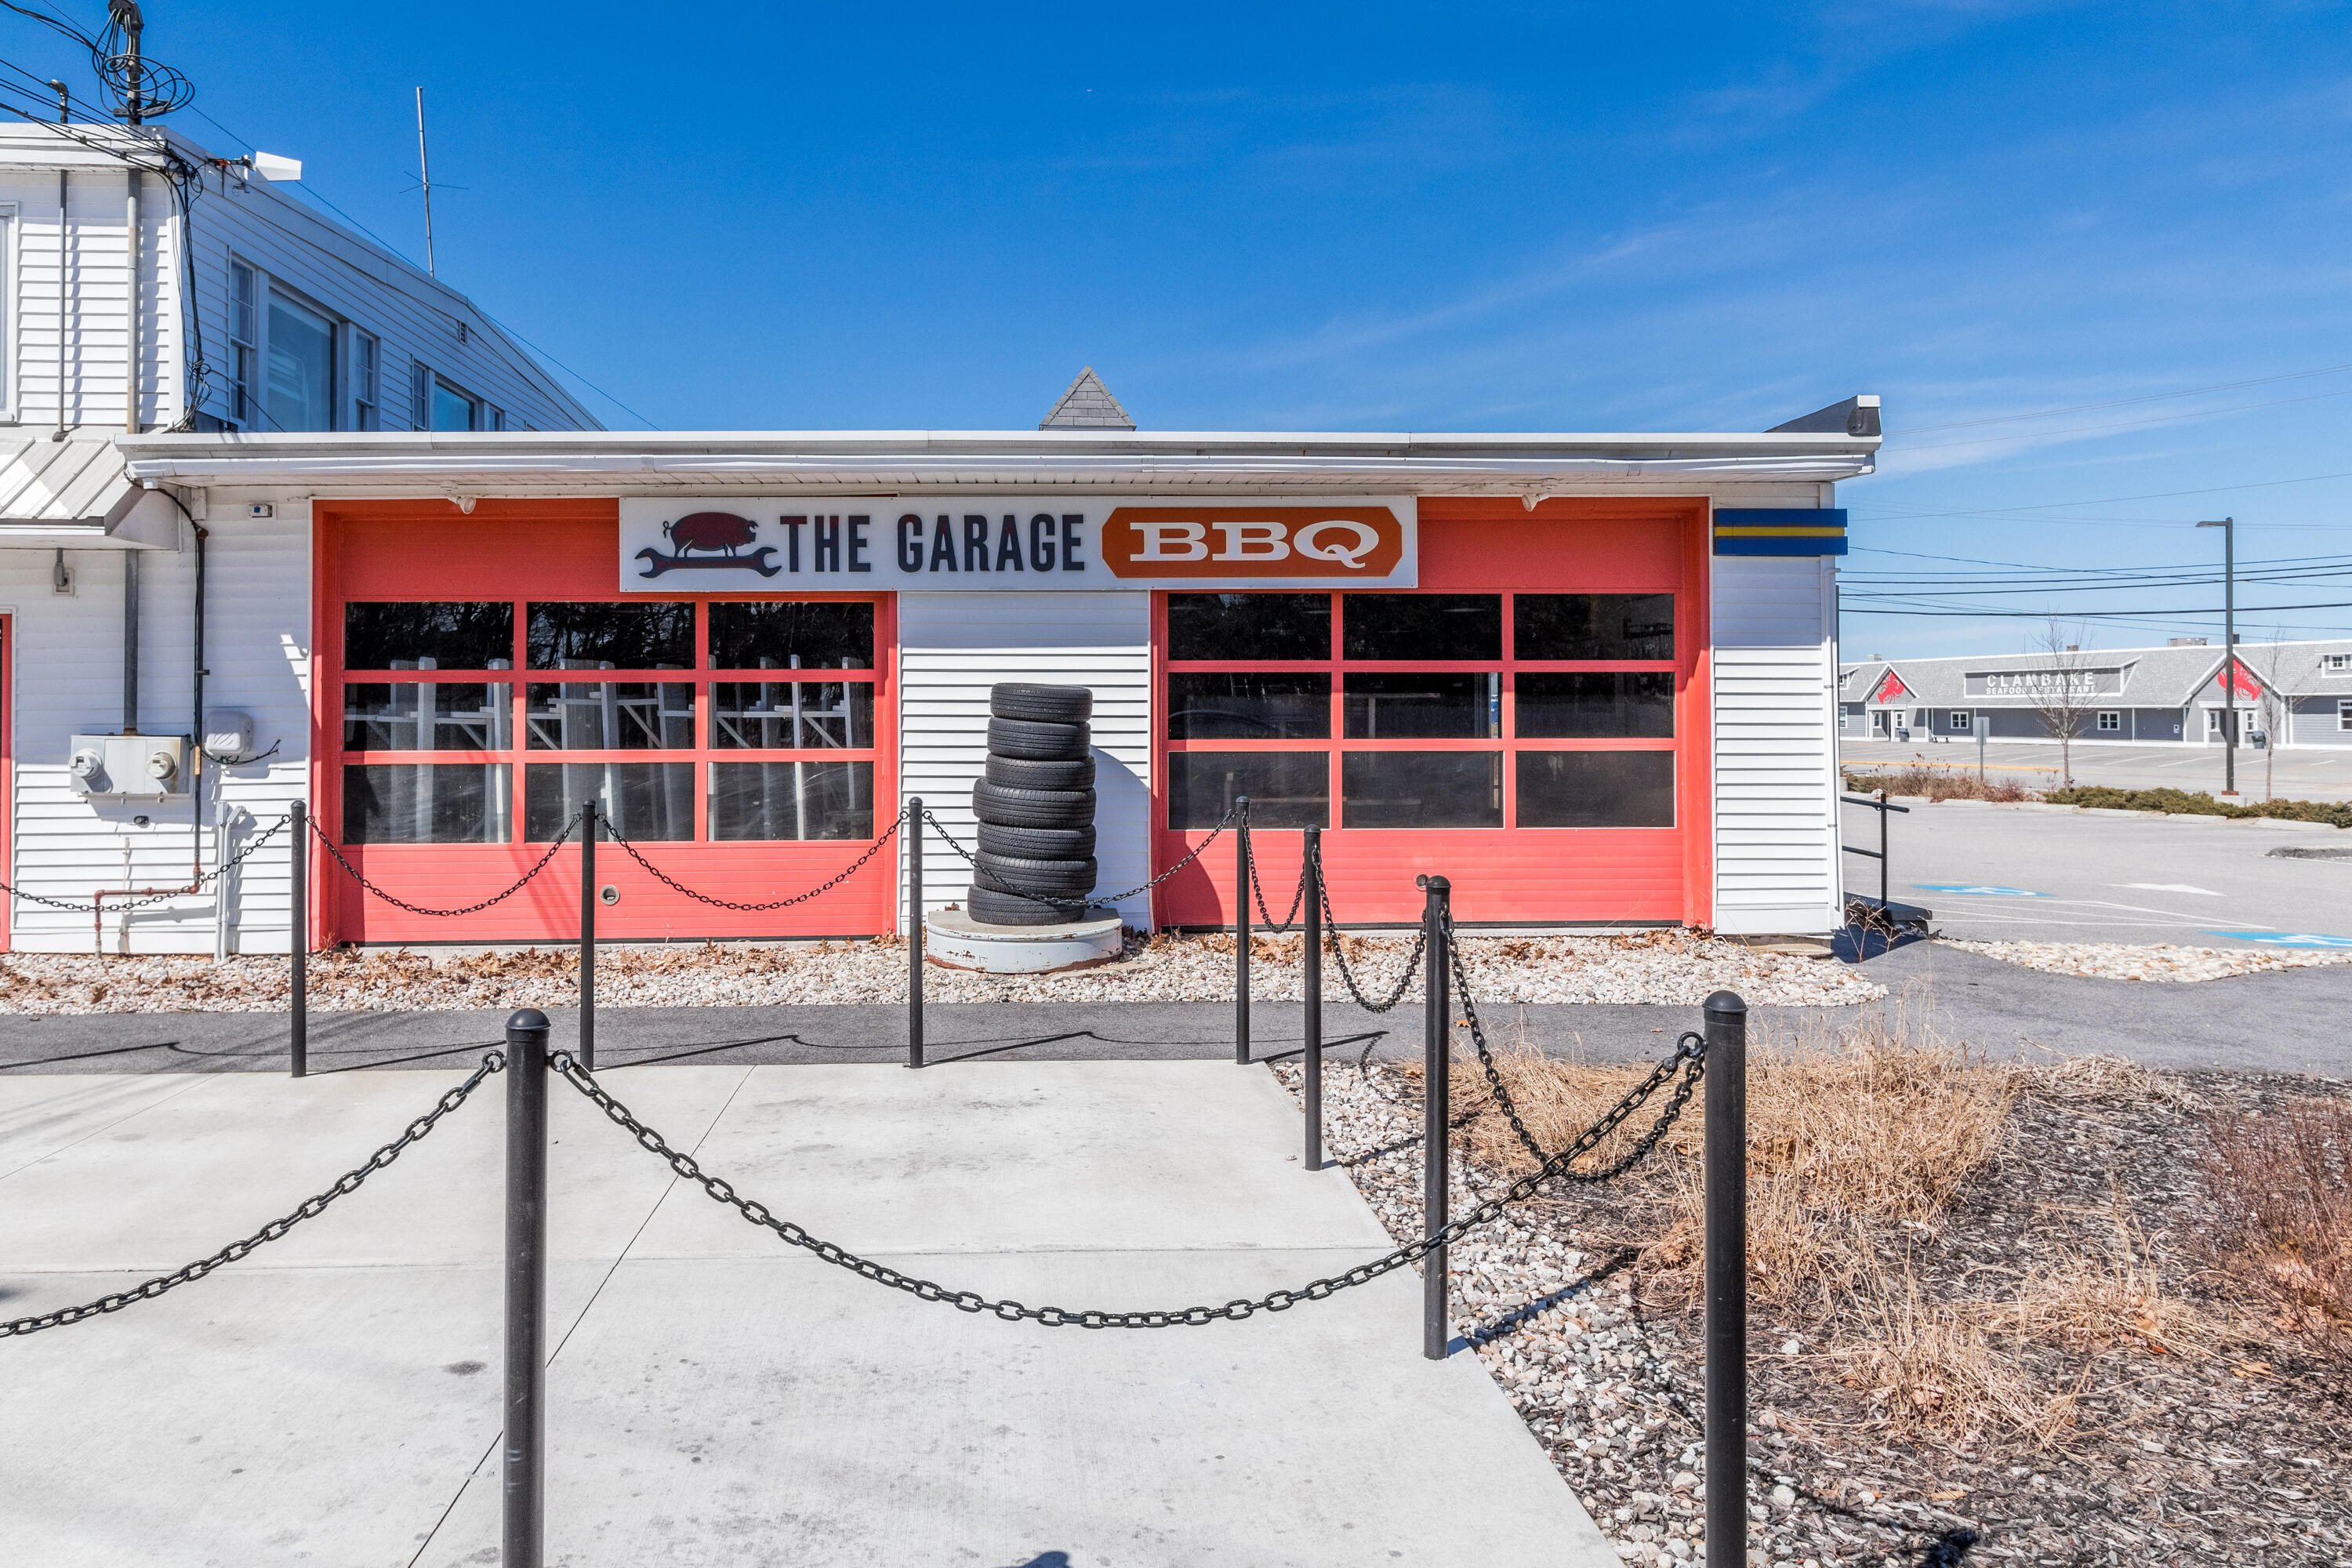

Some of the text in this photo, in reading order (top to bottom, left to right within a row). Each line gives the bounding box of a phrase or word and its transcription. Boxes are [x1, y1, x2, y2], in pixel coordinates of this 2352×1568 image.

[780, 514, 1379, 572] THE GARAGE BBQ
[1987, 672, 2095, 688] CLAMBAKE
